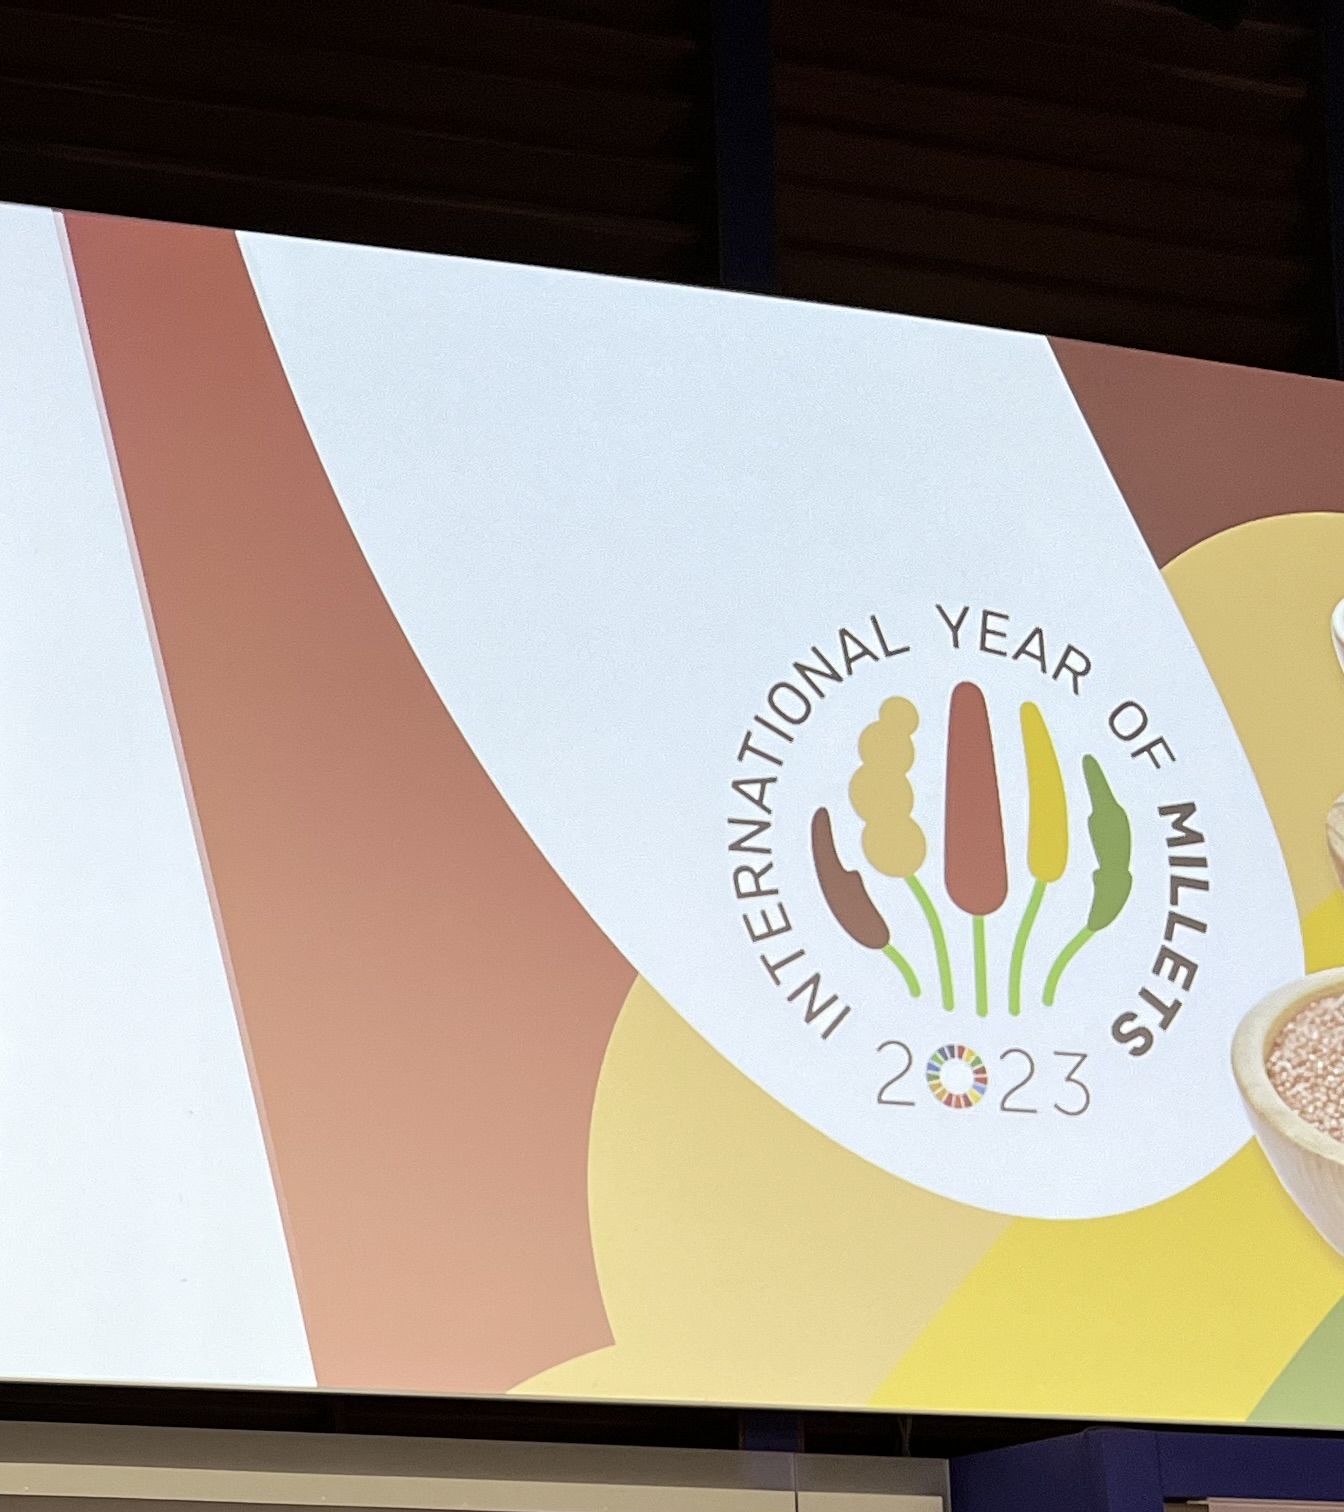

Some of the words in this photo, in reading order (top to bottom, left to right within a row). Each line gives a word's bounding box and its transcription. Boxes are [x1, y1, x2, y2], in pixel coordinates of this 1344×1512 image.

[935, 603, 1093, 696] YEAR
[1107, 699, 1176, 772] OF
[726, 613, 912, 1042] INTERNATIONAL
[1110, 801, 1211, 1058] MILLETS
[876, 1040, 1091, 1117] 2023
